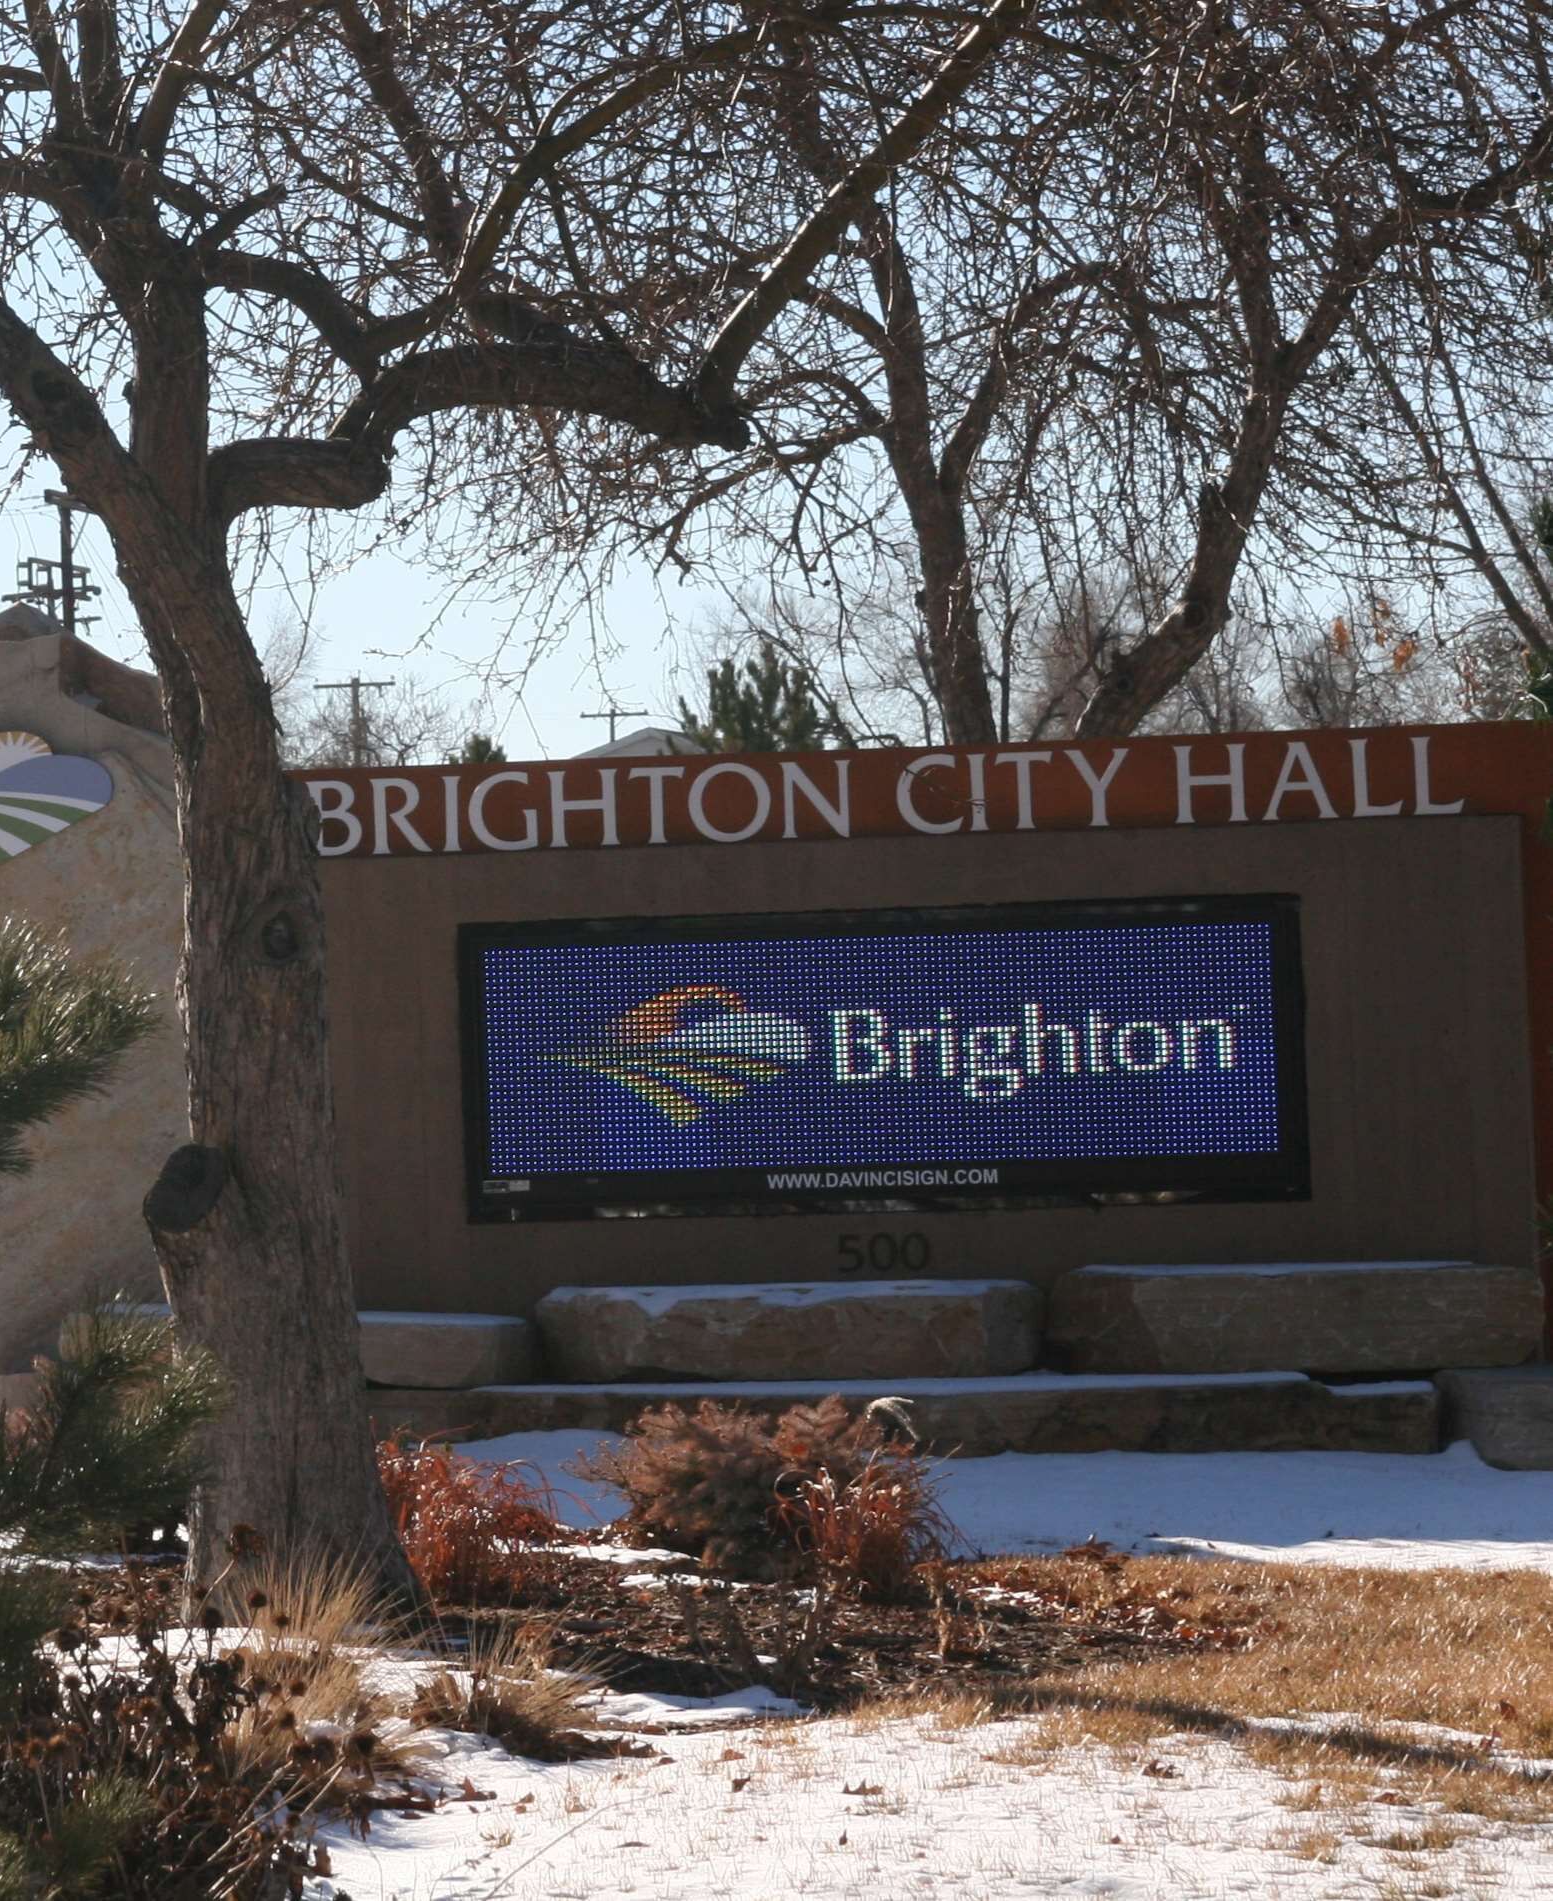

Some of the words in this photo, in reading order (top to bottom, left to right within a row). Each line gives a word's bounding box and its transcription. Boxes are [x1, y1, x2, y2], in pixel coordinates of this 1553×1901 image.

[306, 760, 850, 857] BRIGHTON
[896, 748, 1130, 835] CITY
[1172, 736, 1465, 824] HALL
[828, 1002, 1235, 1101] Brighton
[767, 1168, 999, 1190] WWW.DAVINCISIGN.COM
[837, 1231, 930, 1273] 500
